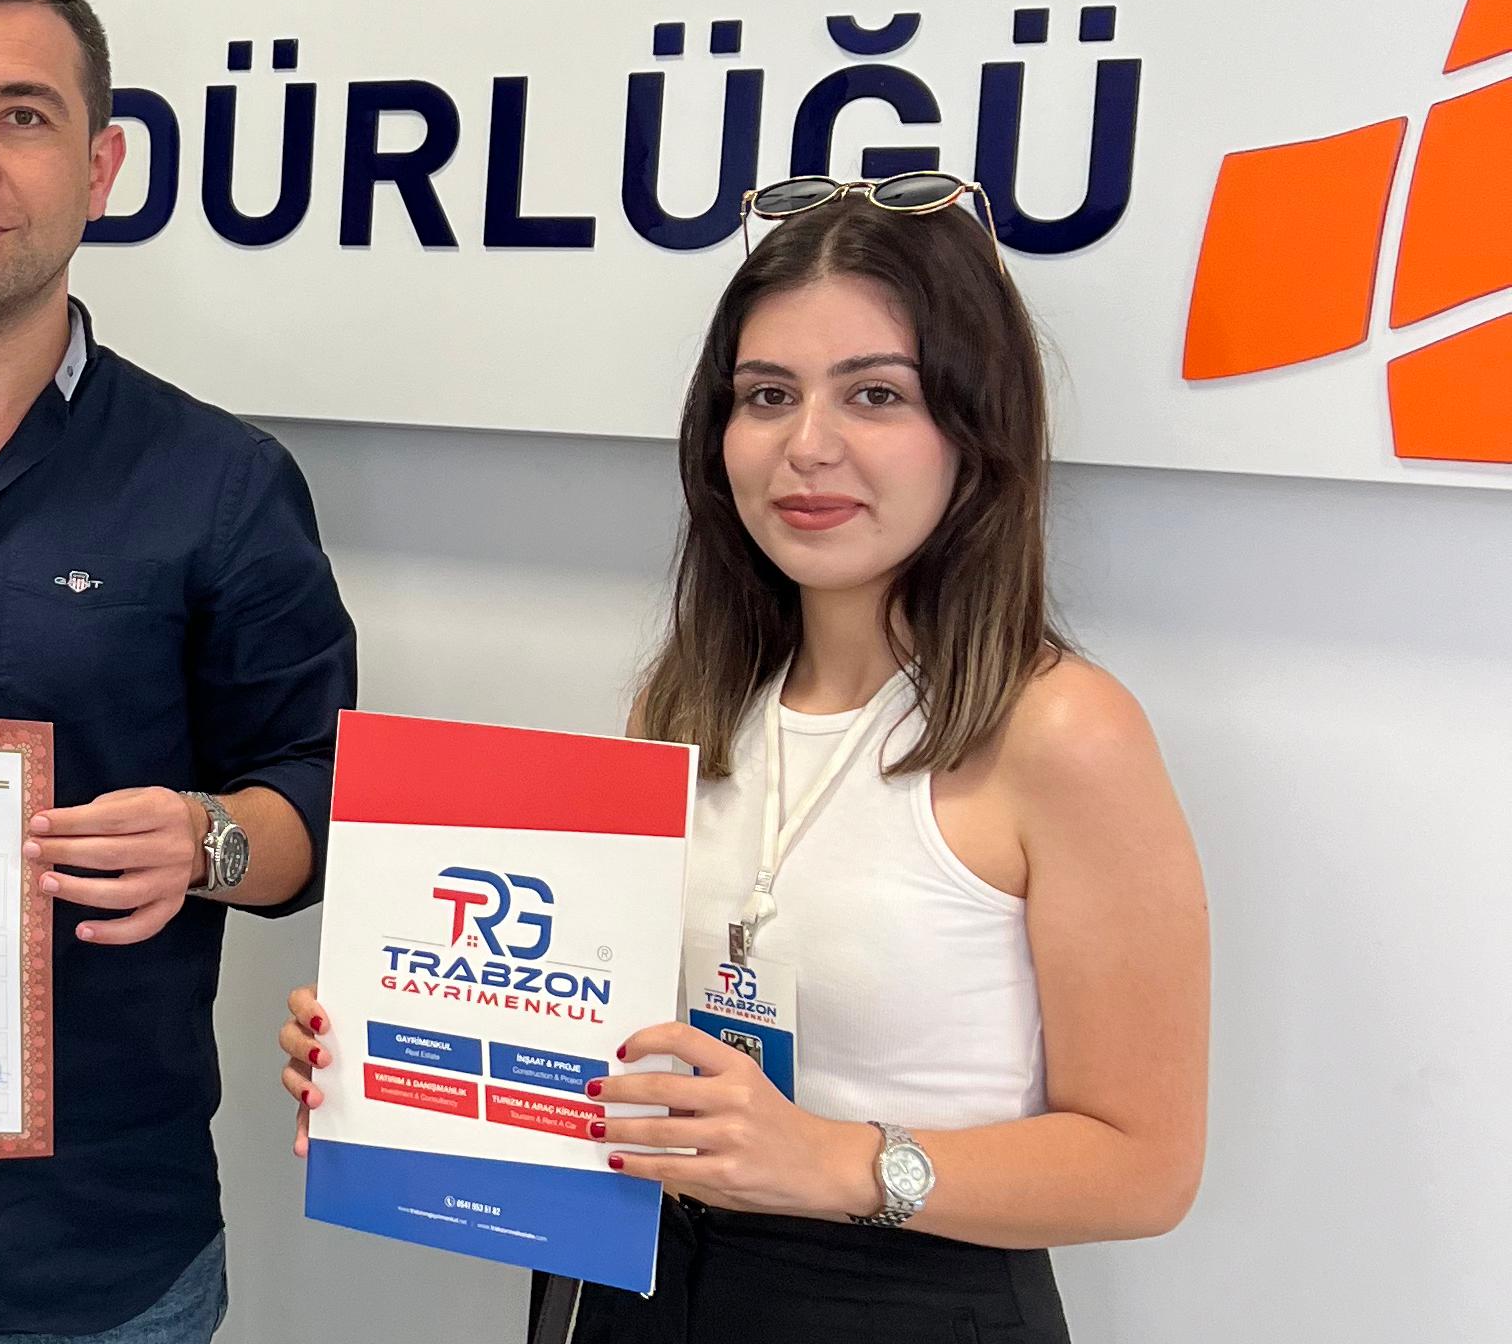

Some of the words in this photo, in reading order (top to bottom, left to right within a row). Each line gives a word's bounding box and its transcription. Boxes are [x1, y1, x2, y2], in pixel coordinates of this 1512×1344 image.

[382, 945, 611, 1005] TRABZON
[381, 974, 605, 1024] GAYRİMENKUL
[704, 991, 776, 1018] TRABZON
[554, 1061, 582, 1073] PROJE
